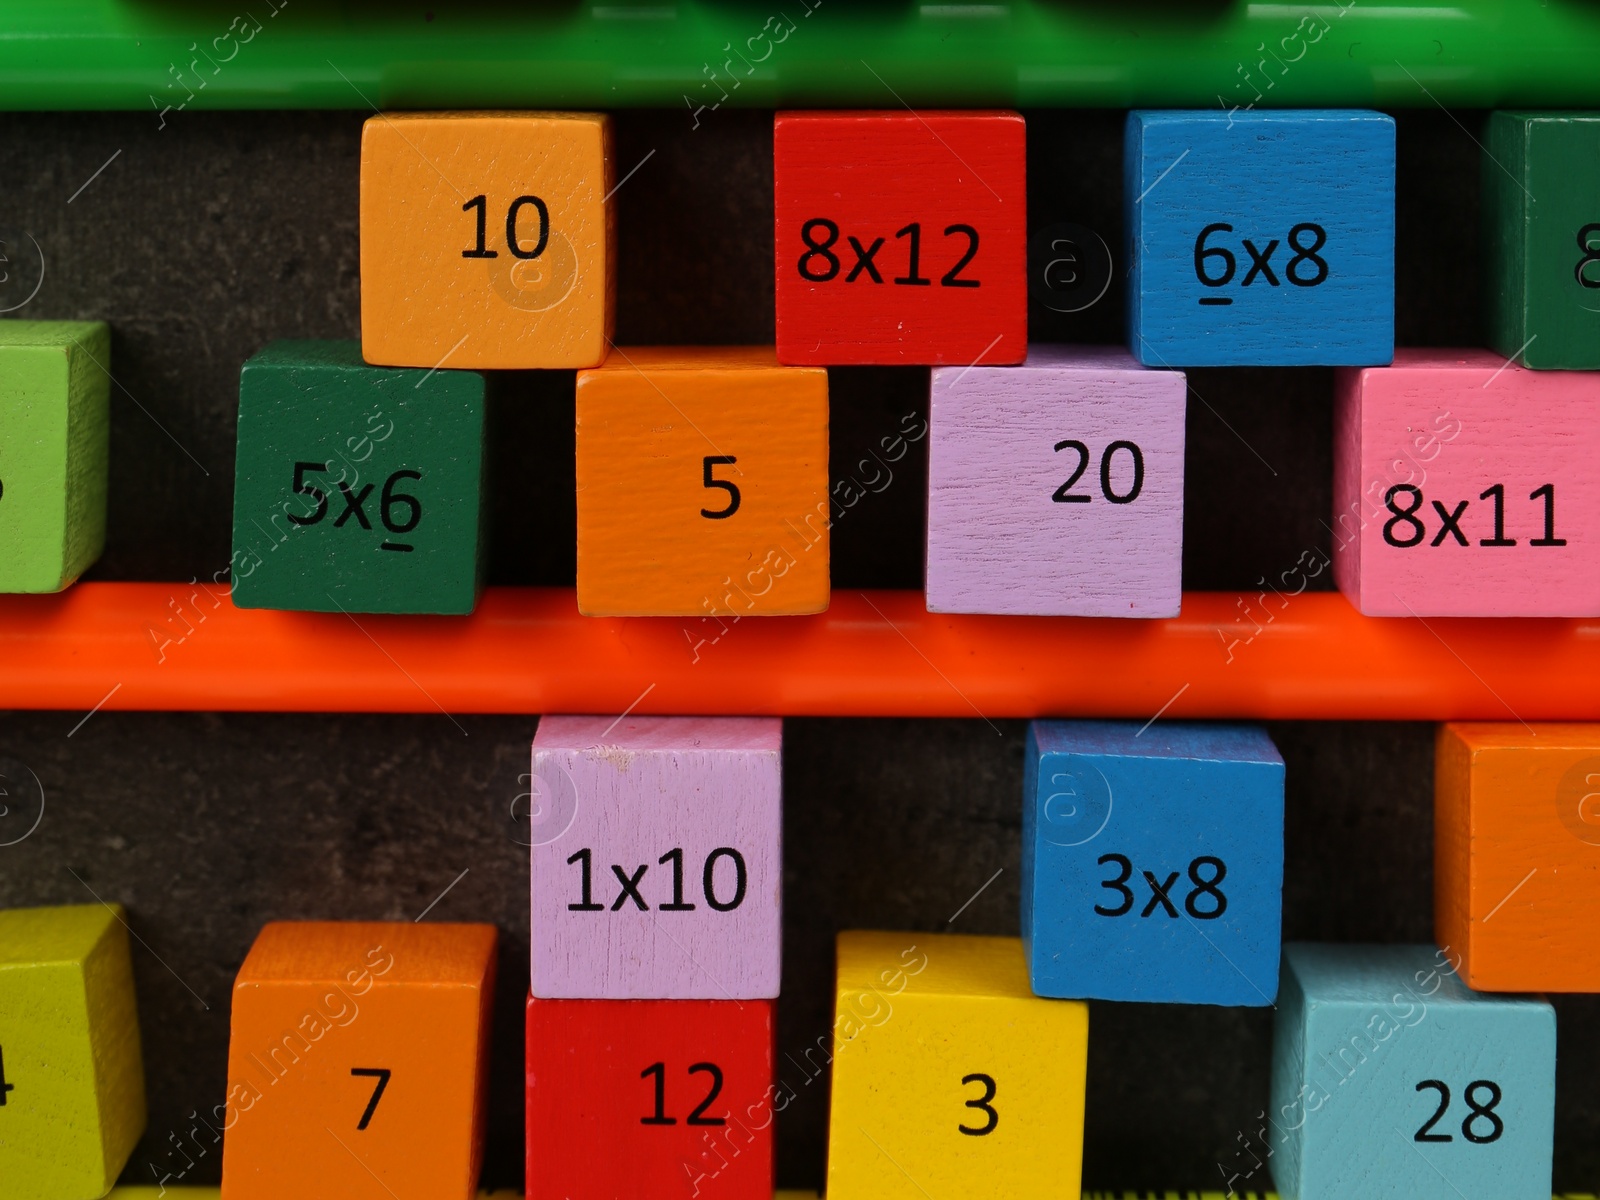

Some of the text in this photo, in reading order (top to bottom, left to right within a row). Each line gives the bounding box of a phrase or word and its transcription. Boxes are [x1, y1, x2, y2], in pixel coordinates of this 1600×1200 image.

[461, 194, 550, 260] 10
[798, 219, 981, 288] 8x12
[1194, 223, 1329, 288] 6x8
[287, 462, 422, 534] 5x6
[701, 456, 741, 519] 5
[1052, 440, 1145, 504] 20
[1382, 484, 1567, 548] 8x11
[566, 847, 747, 912] 1x10
[1094, 853, 1228, 920] 3x8
[350, 1068, 391, 1131] 7
[640, 1062, 726, 1126] 12
[958, 1073, 999, 1137] 3
[1413, 1080, 1504, 1144] 28
